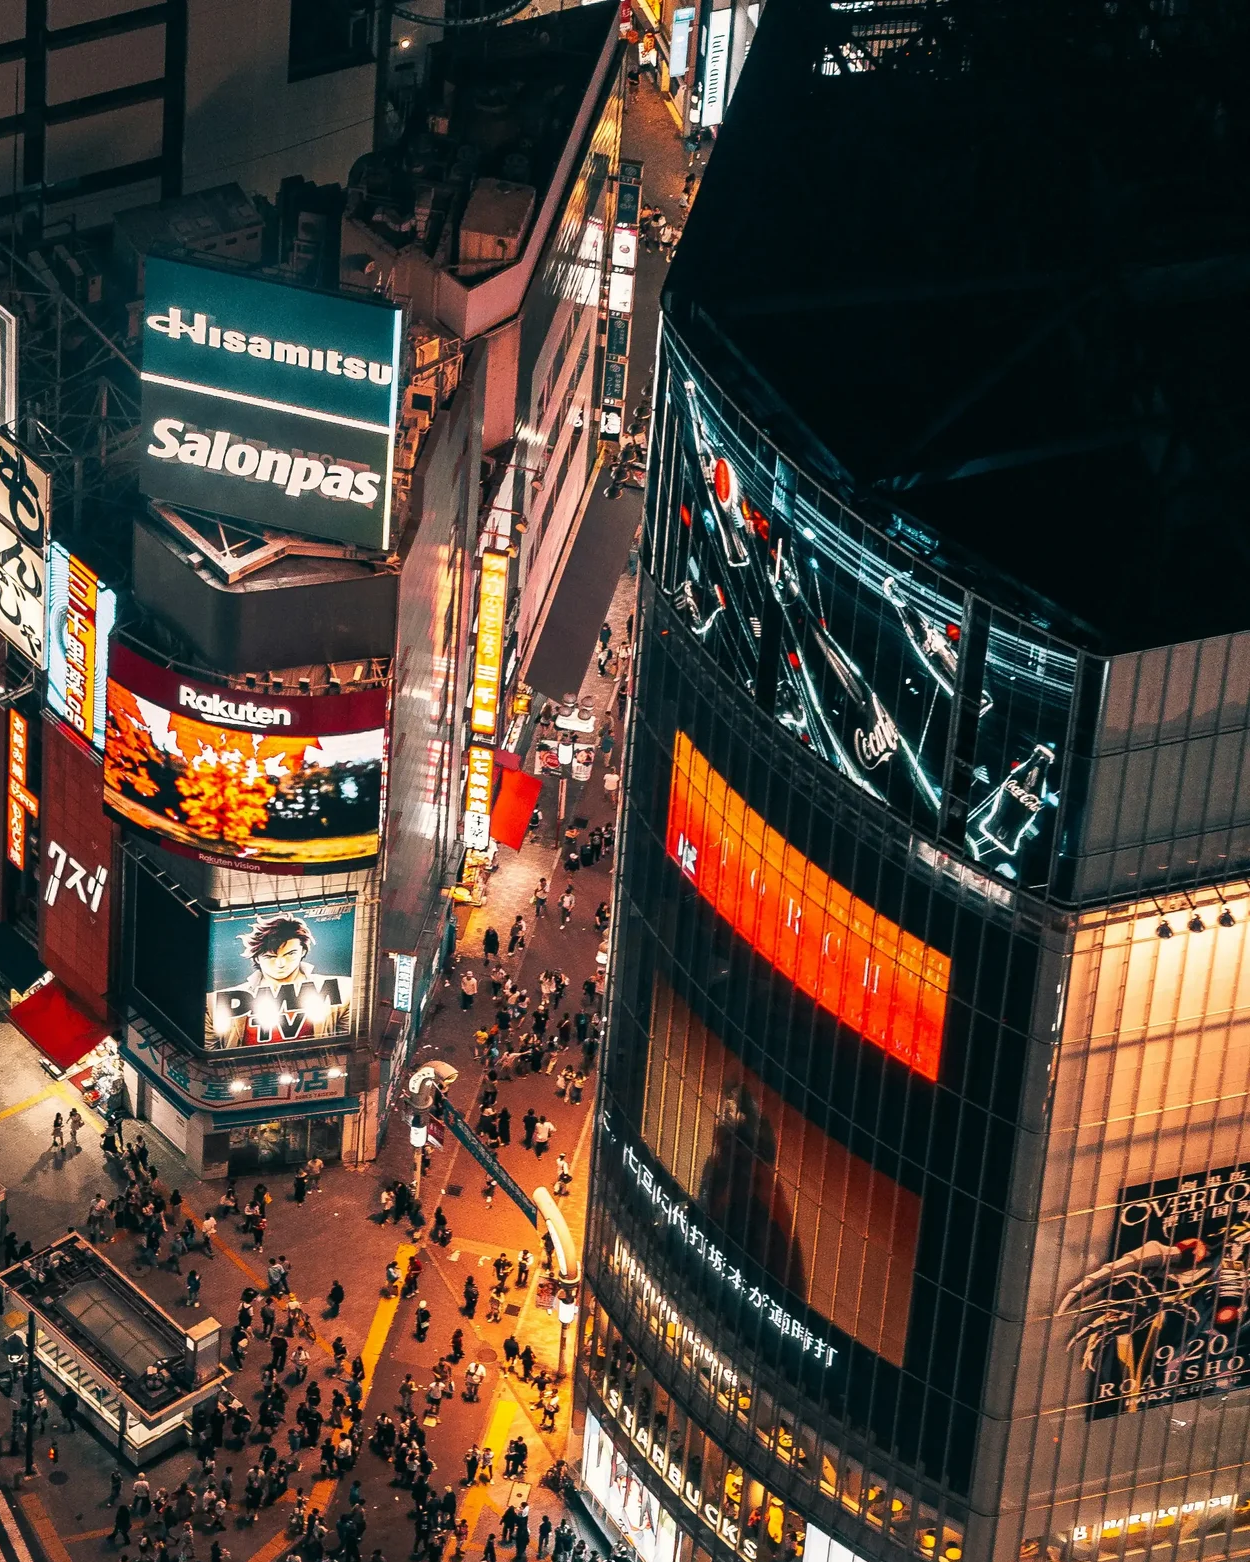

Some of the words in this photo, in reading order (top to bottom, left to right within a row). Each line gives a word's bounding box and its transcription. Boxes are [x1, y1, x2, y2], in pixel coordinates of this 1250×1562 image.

[146, 307, 393, 386] Hisamitsu
[147, 418, 381, 504] Salonpas
[179, 684, 291, 727] Rakuten
[198, 852, 234, 869] Rakuten
[235, 862, 262, 872] Vision
[216, 977, 343, 1019] DMM
[249, 1007, 306, 1043] TV
[1119, 1181, 1250, 1226] OVERLO
[1099, 1353, 1250, 1400] ROADSHO
[608, 1388, 759, 1562] STARBUCKS
